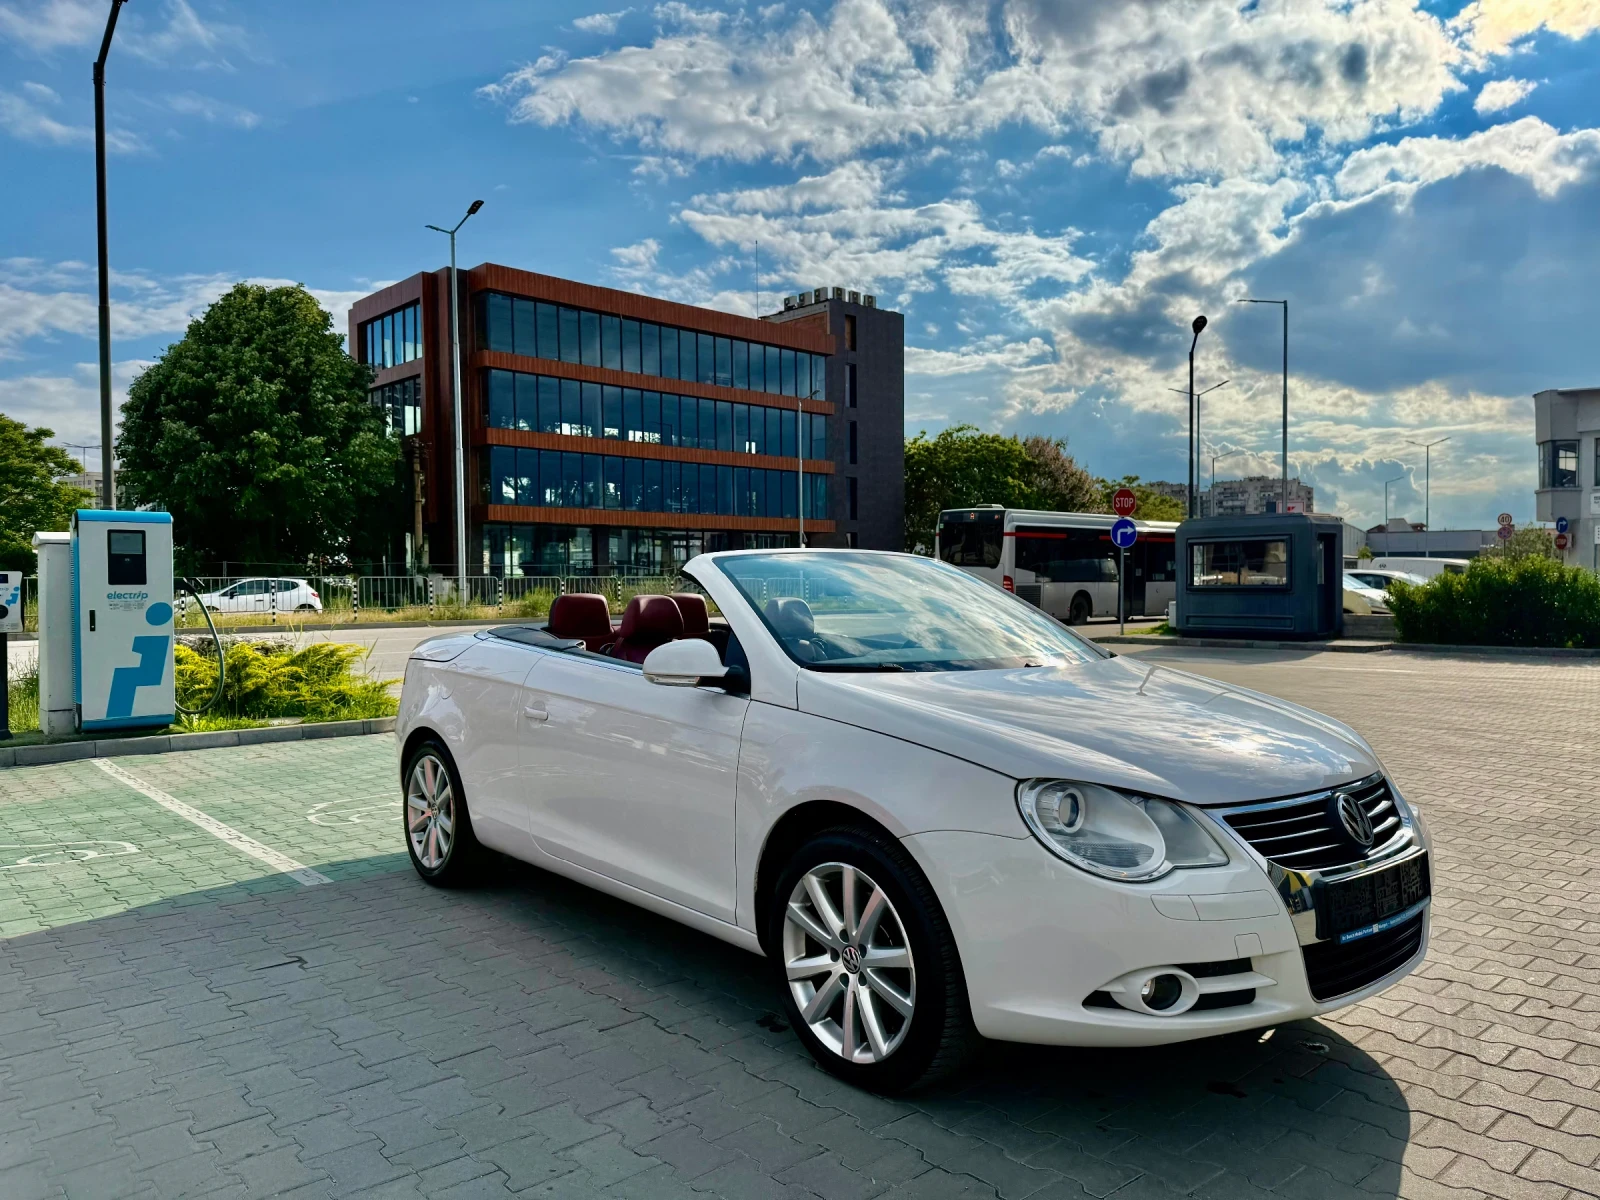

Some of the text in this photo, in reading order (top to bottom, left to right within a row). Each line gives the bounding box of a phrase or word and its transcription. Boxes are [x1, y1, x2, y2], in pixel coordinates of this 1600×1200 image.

[1115, 497, 1133, 508] STOP
[1500, 516, 1510, 524] 40
[106, 591, 148, 600] electrip
